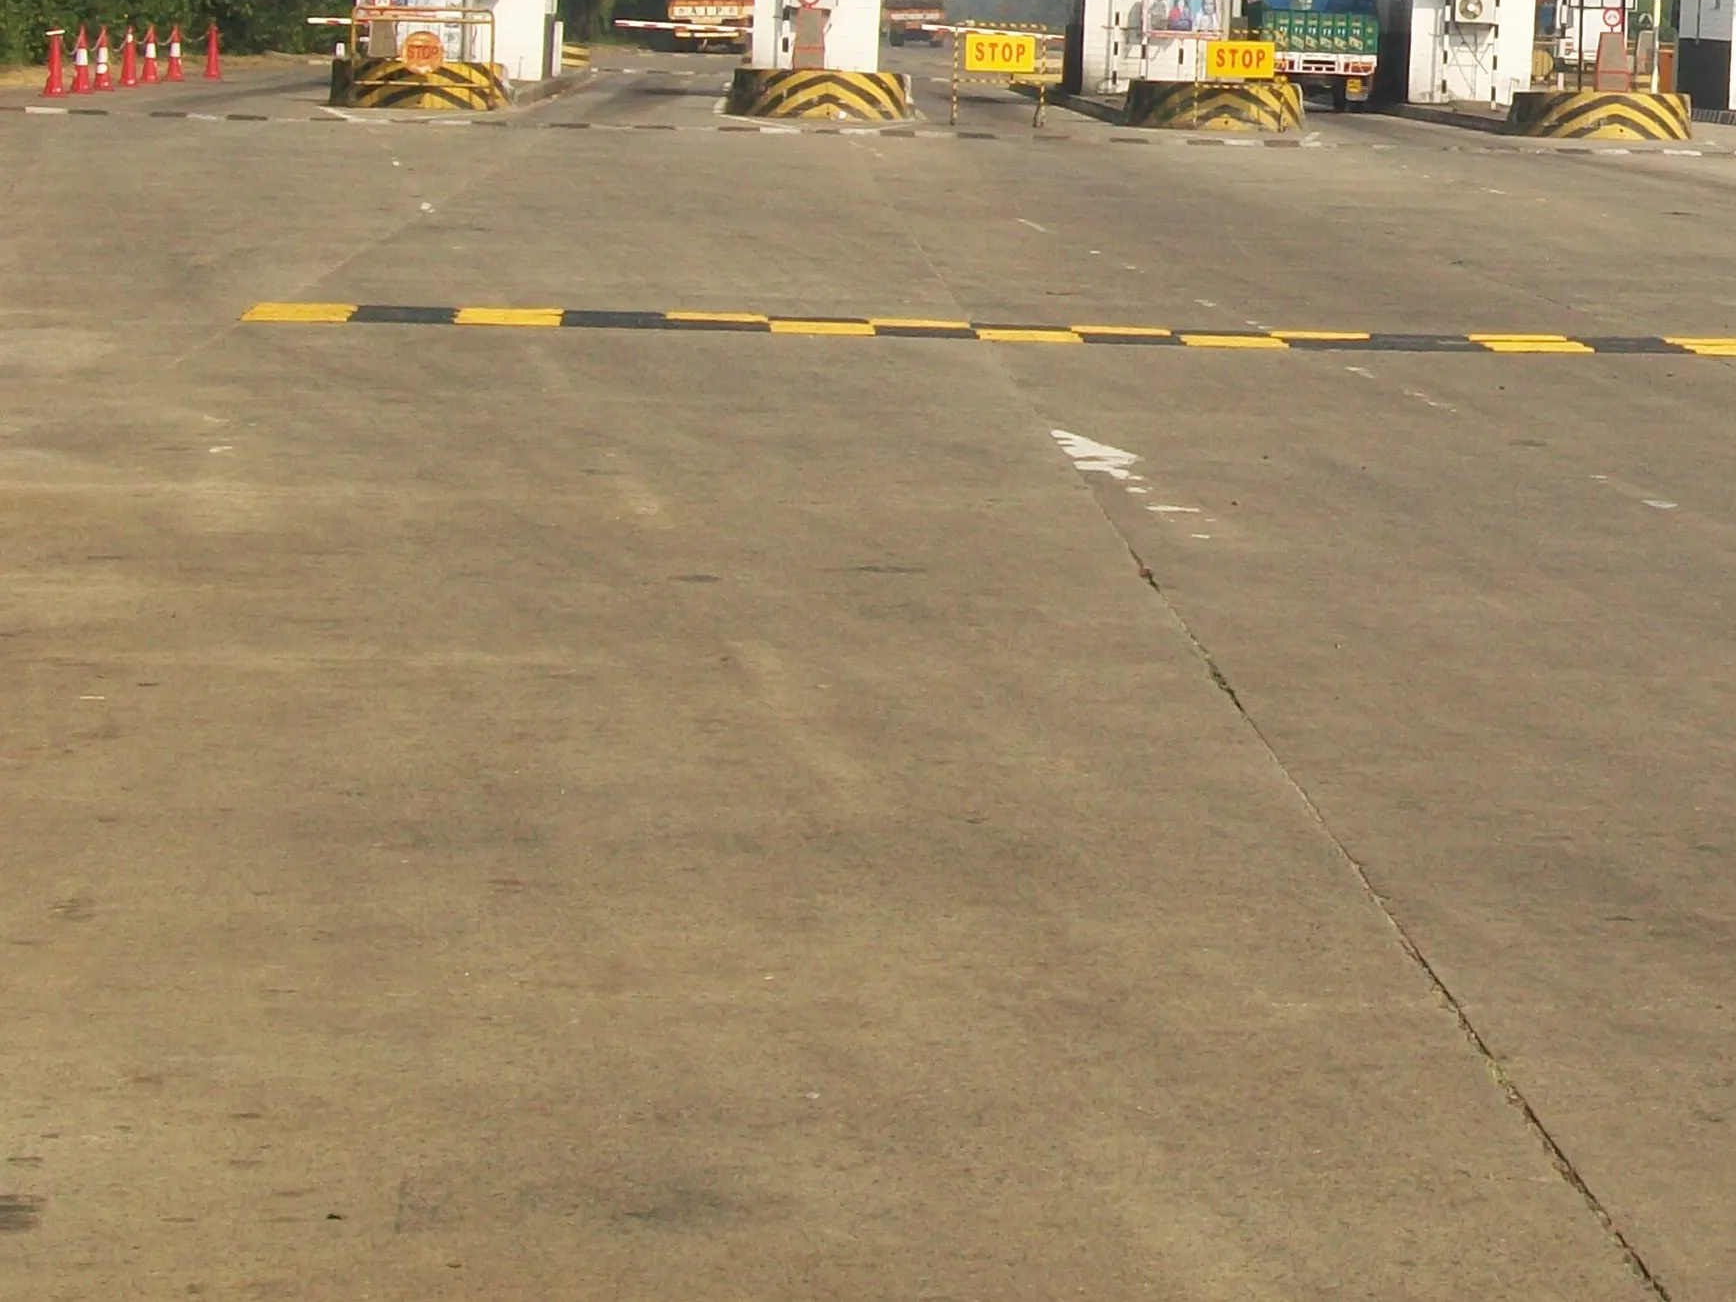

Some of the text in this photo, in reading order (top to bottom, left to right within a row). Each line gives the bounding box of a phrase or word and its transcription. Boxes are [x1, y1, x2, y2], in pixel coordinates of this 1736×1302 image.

[407, 43, 440, 60] STOP
[975, 41, 1026, 64] STOP
[1216, 48, 1266, 69] STOP
